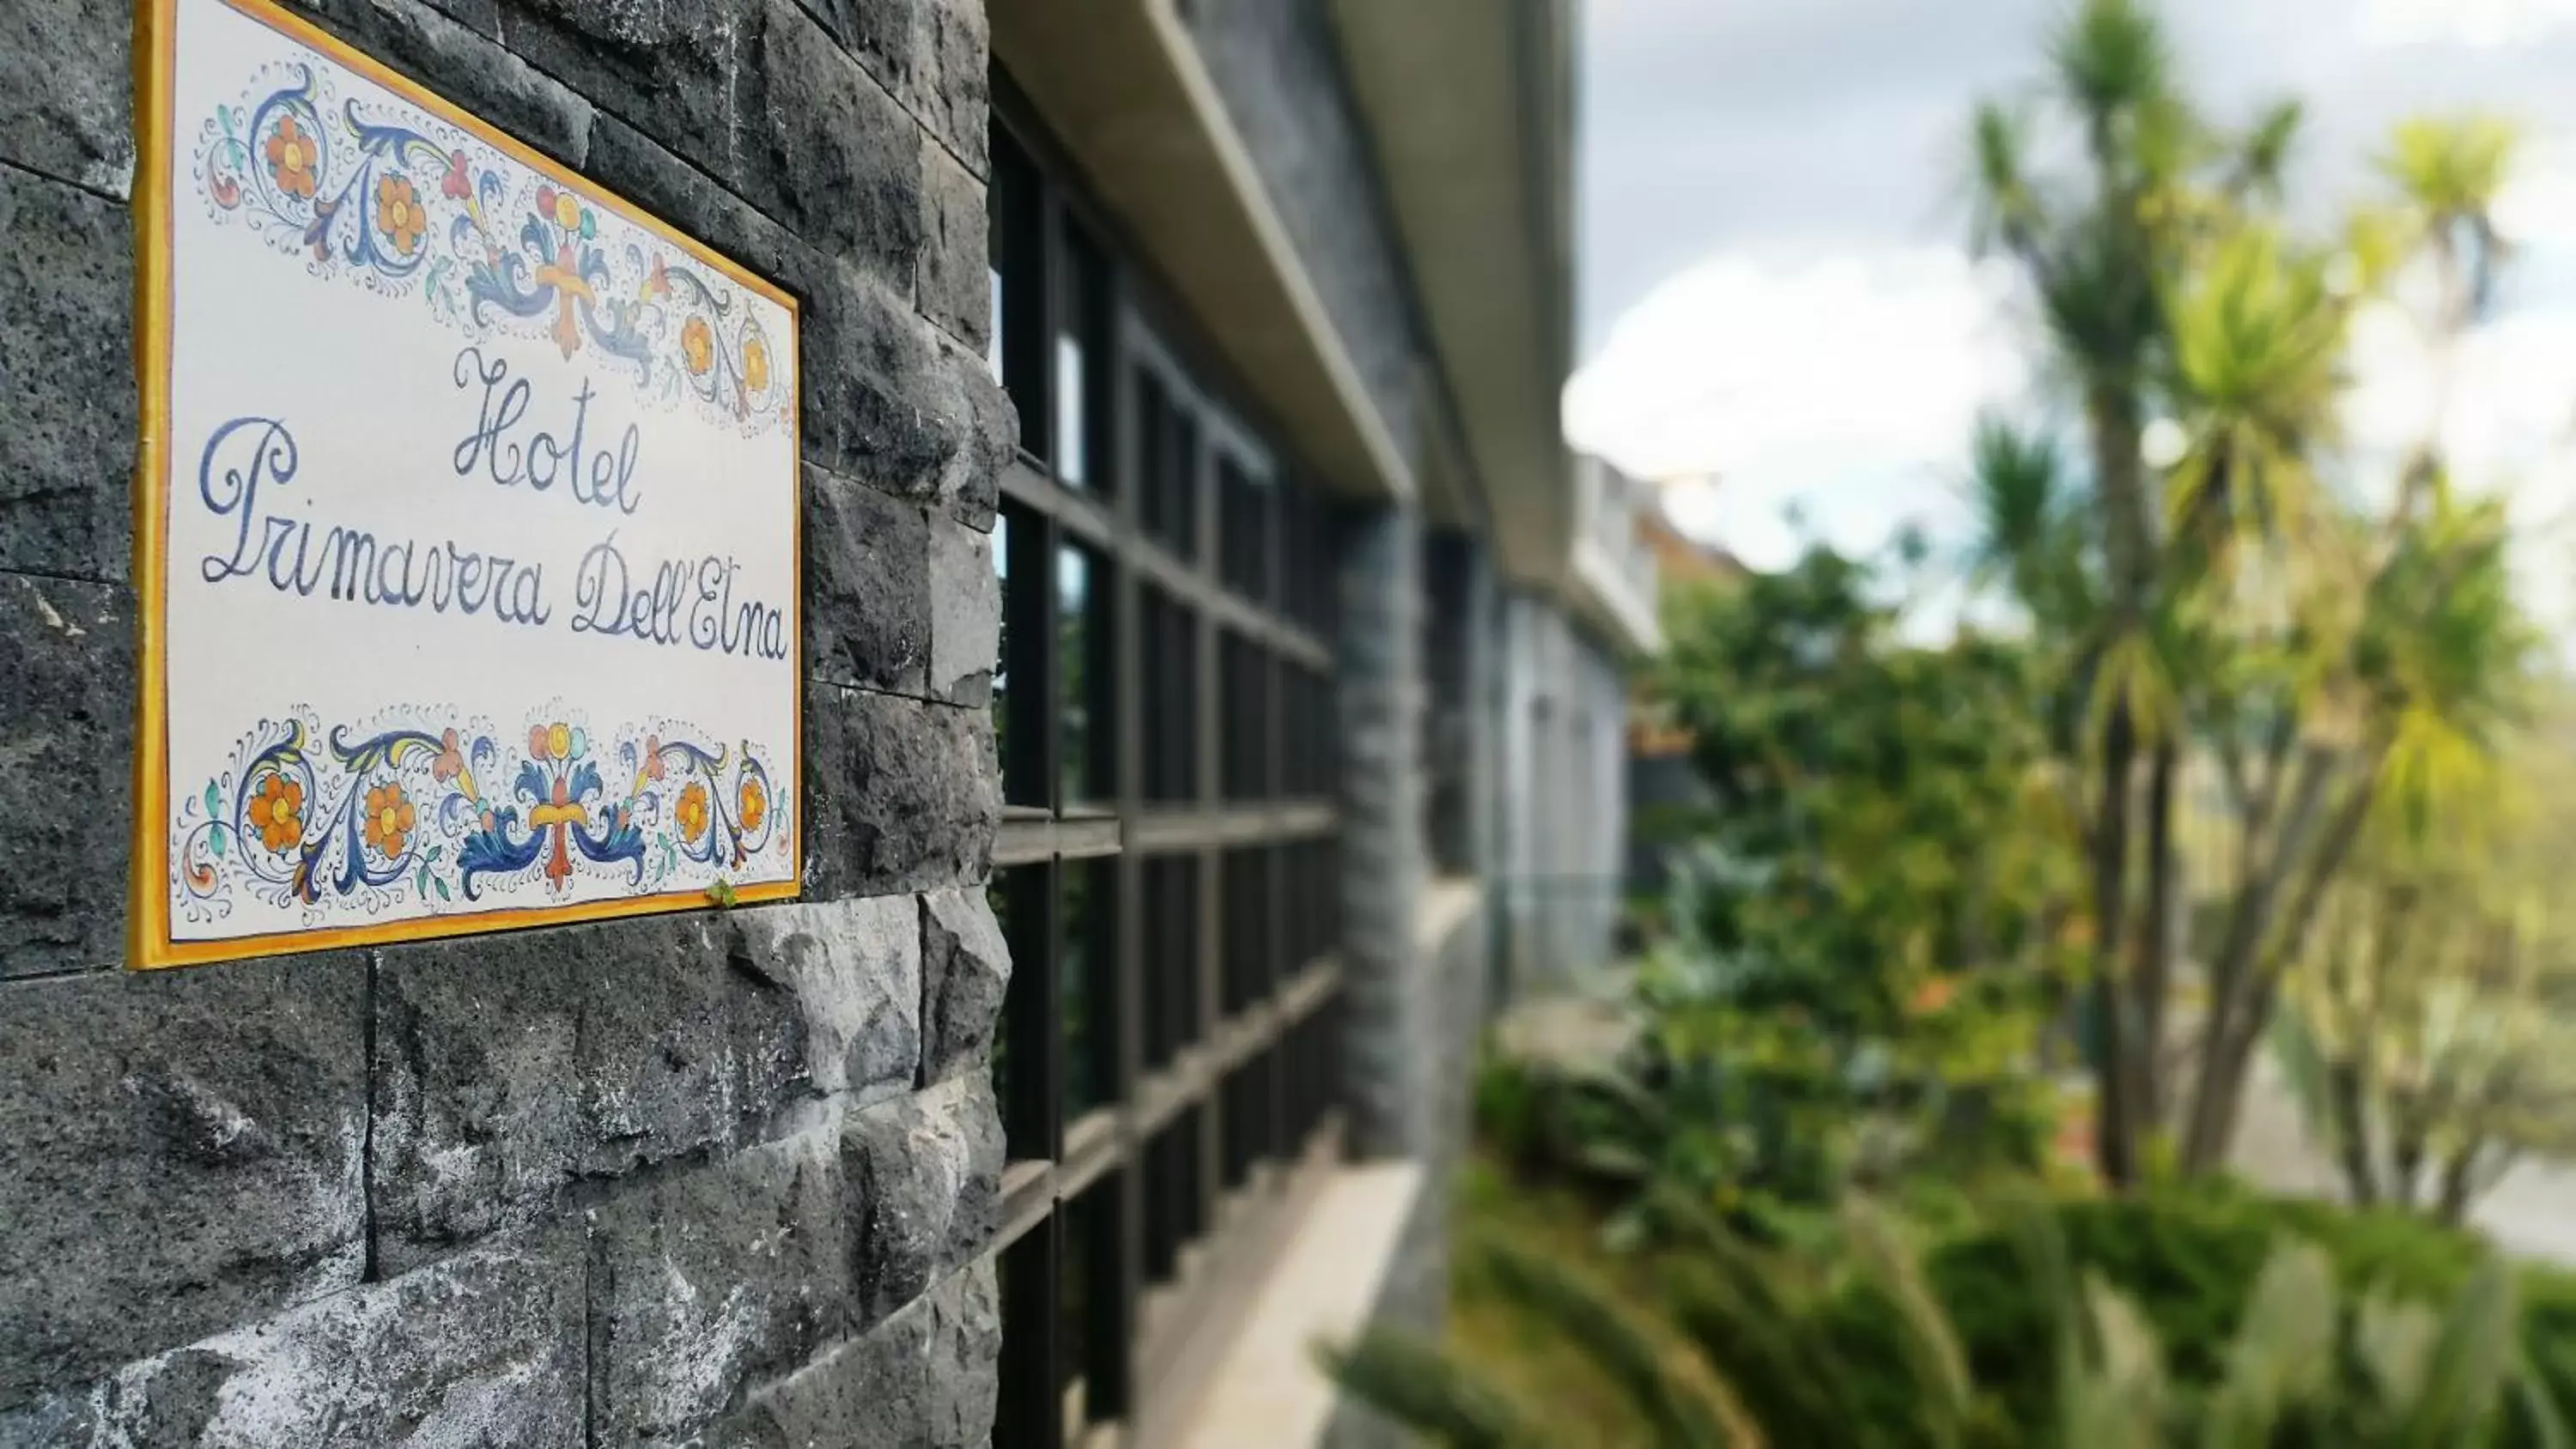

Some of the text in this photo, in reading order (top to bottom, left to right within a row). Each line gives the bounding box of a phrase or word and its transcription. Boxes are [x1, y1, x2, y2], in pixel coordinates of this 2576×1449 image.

[453, 347, 641, 514] Hotel
[199, 416, 788, 660] Primavera Dell'Etna
